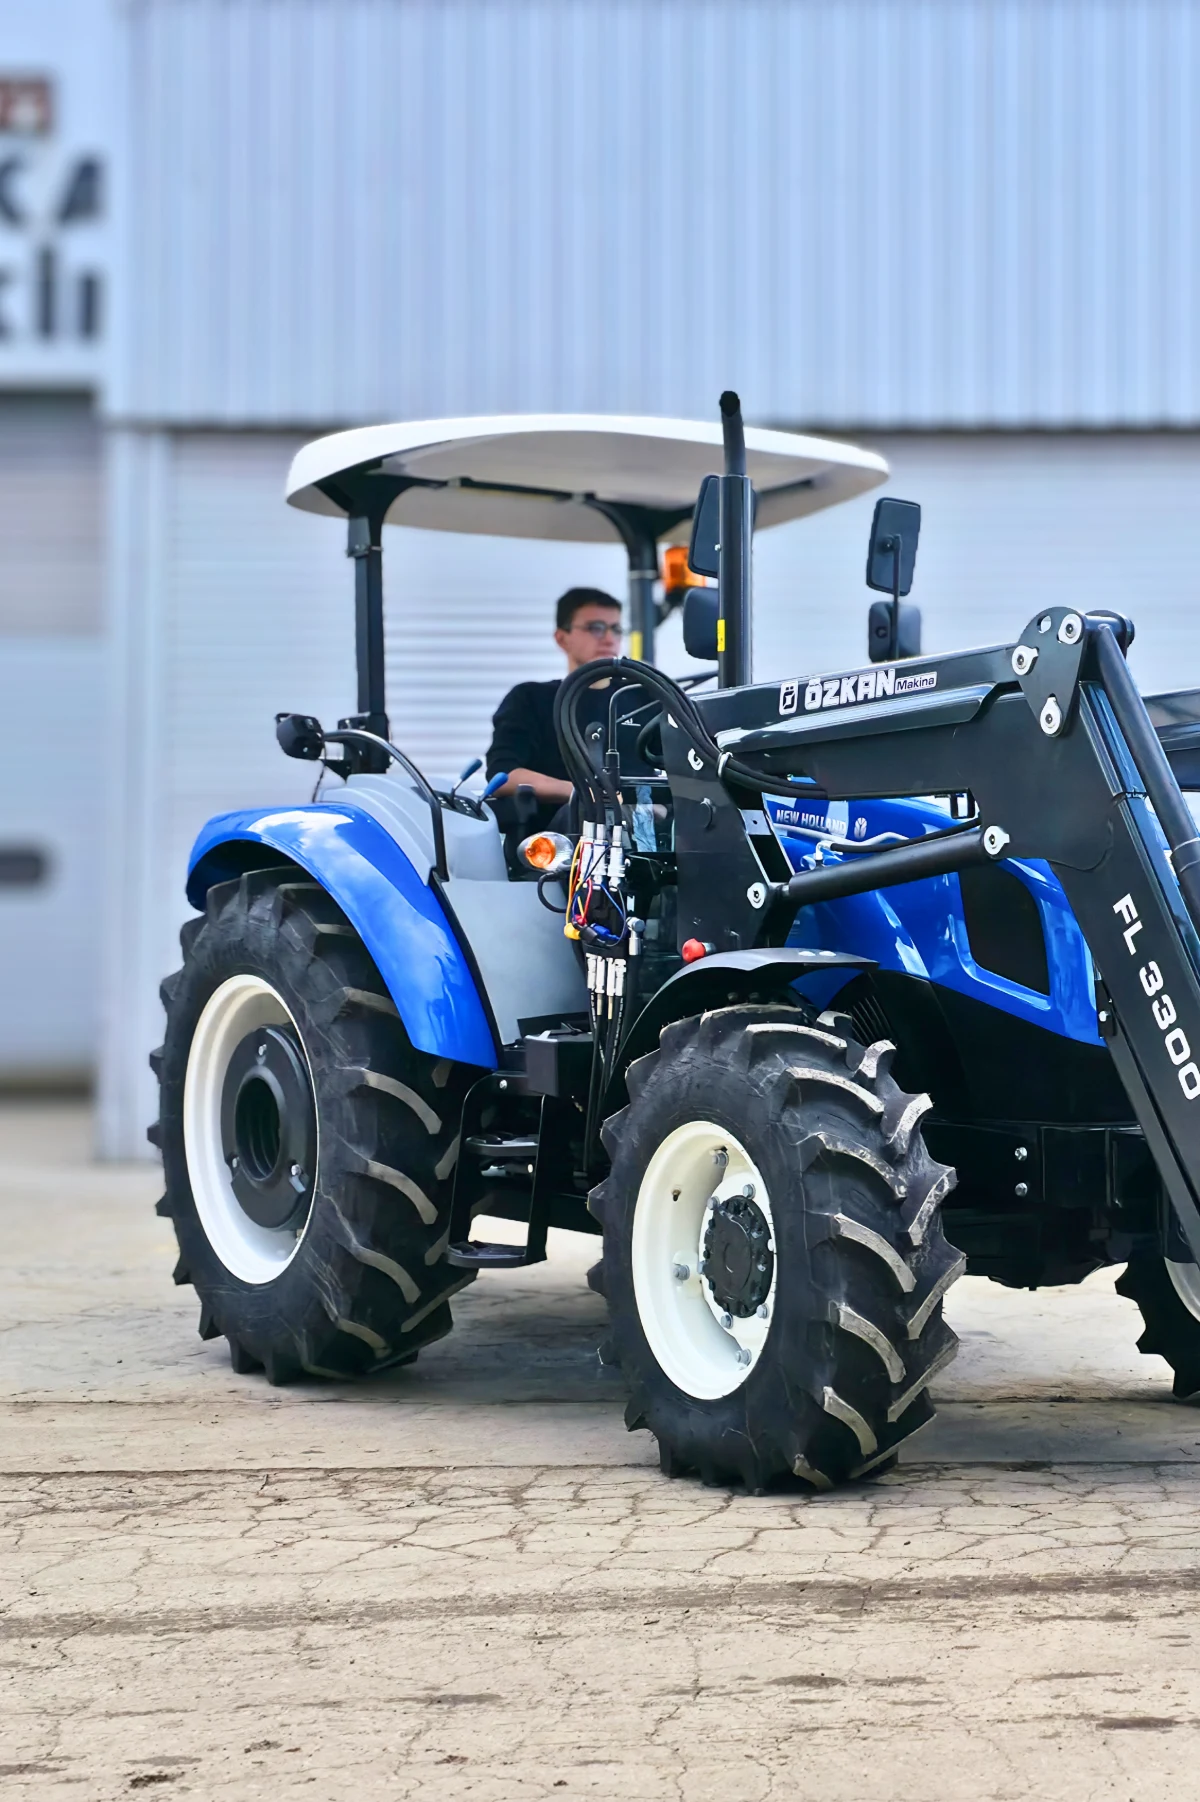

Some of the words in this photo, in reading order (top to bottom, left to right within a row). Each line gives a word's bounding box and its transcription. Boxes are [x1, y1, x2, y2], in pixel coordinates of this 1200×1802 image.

[805, 668, 895, 710] ÖZKAN
[896, 676, 935, 692] Makina
[776, 809, 800, 825] NEW
[801, 812, 847, 833] HOLLAND
[1112, 893, 1143, 956] FL
